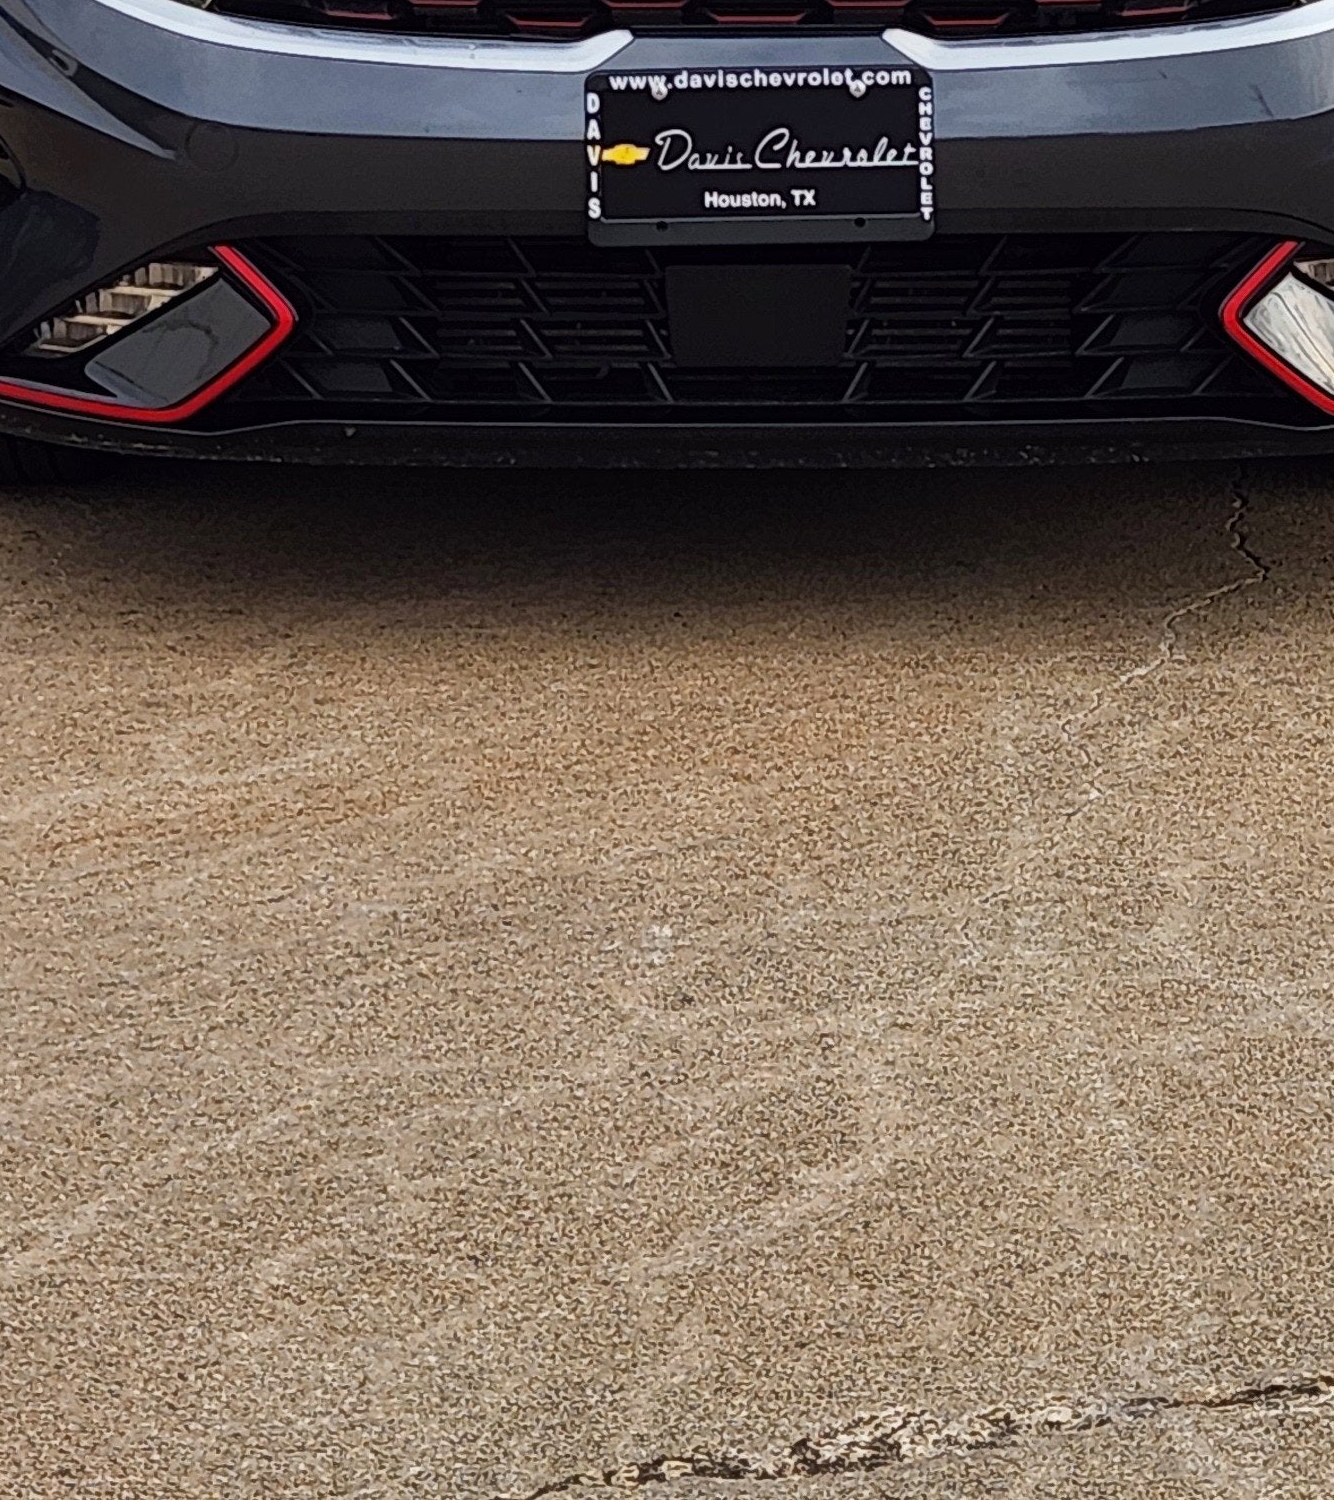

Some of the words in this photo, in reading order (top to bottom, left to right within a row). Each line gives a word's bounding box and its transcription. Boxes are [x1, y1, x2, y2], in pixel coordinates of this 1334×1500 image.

[586, 92, 602, 219] DAVIS
[654, 128, 753, 171] Davis
[754, 127, 919, 169] Chevrolet
[918, 86, 934, 221] CHEVROLET
[704, 190, 787, 209] Houston,
[790, 188, 816, 206] TX
